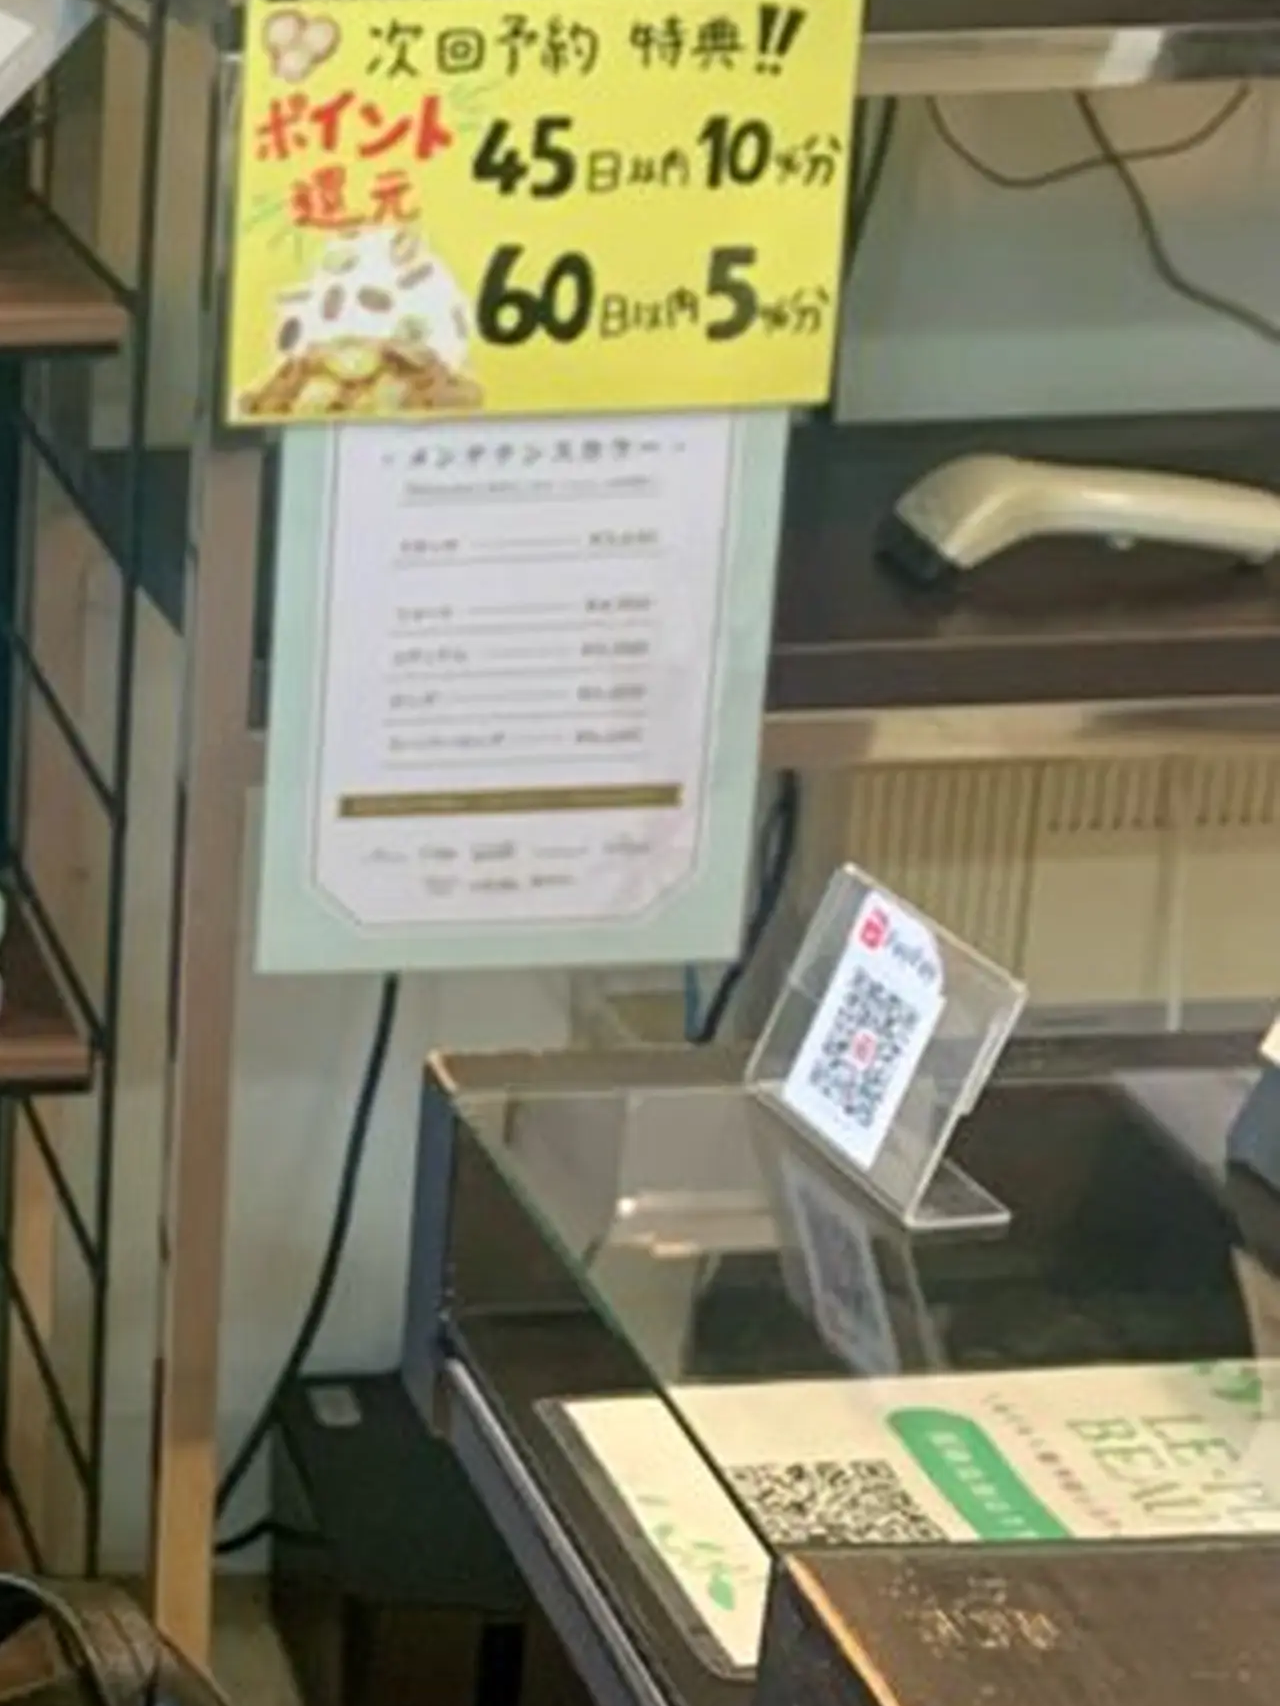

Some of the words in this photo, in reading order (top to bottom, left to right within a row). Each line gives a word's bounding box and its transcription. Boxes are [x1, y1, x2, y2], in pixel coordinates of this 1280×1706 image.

[365, 14, 600, 76] 次回予約
[255, 92, 454, 161] ポイント
[289, 166, 421, 229] 還元
